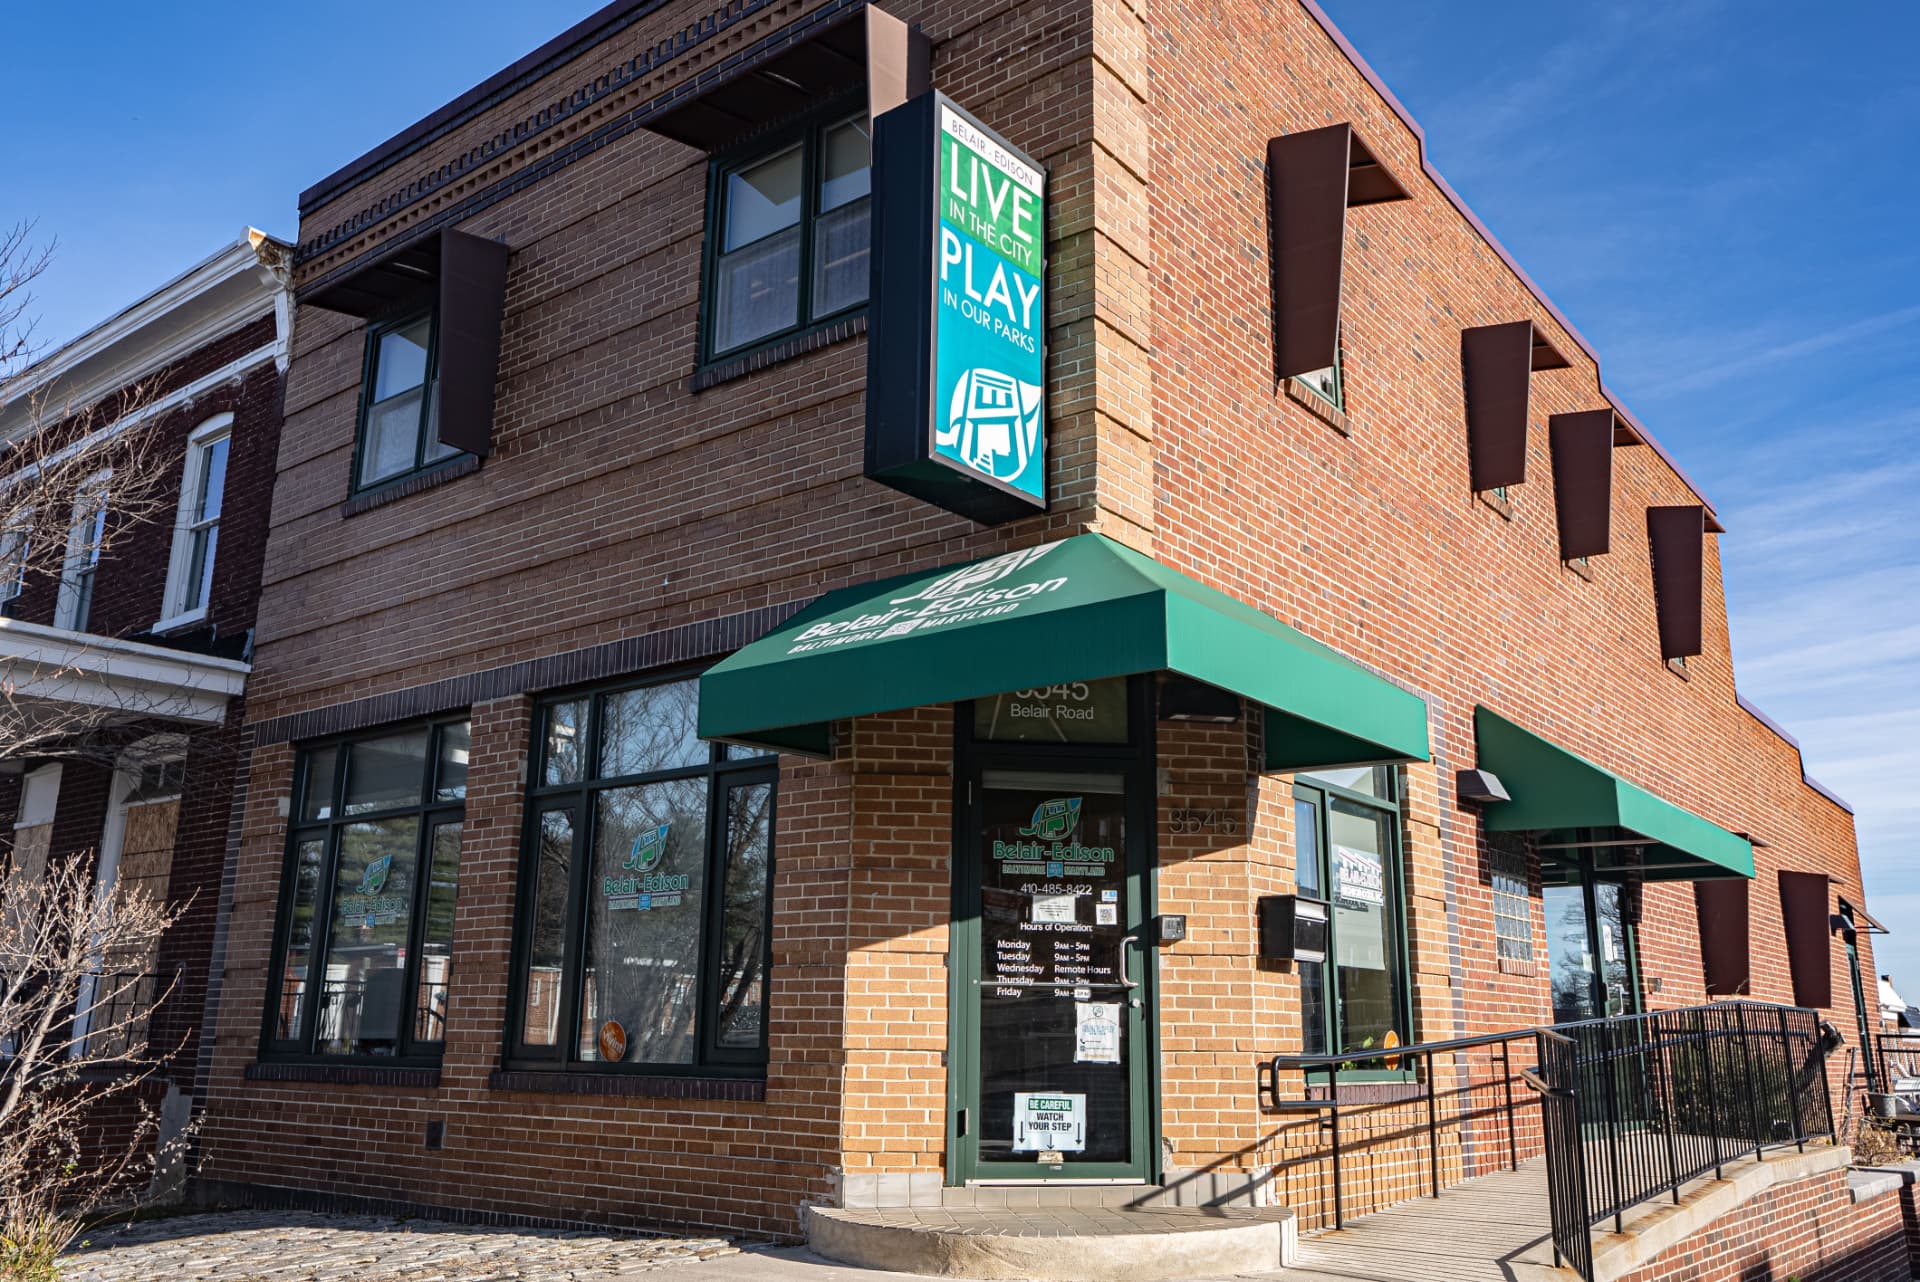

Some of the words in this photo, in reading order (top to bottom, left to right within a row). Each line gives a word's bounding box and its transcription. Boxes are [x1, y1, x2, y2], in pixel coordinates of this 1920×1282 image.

[952, 119, 986, 155] BELAIR
[994, 150, 1033, 186] EDISON
[951, 141, 1033, 244] LIVE
[949, 198, 965, 225] IN
[969, 211, 996, 245] THE
[1000, 233, 1032, 267] CITY
[941, 225, 1040, 330] PLAY
[944, 287, 957, 310] IN
[961, 299, 990, 330] OUR
[994, 318, 1035, 353] PARKS
[793, 577, 1068, 641] Belair-Edison
[918, 603, 1020, 629] MARYLAND
[1010, 703, 1051, 718] Belair
[1056, 704, 1094, 720] Road
[1168, 808, 1238, 835] 3545
[993, 840, 1115, 863] Belair-Edison
[603, 872, 689, 895] Belair-Edison
[1020, 883, 1093, 896] 410-485-8422
[1020, 922, 1042, 932] Hours
[1044, 923, 1053, 931] of
[997, 940, 1031, 951] Monday
[997, 951, 1030, 962] Tuesday
[997, 963, 1045, 974] Wednesday
[1054, 964, 1086, 973] Remote
[1087, 965, 1111, 974] Hours
[997, 975, 1034, 986] Thursday
[997, 987, 1022, 997] Friday
[1030, 1099, 1040, 1109] BE
[1041, 1099, 1072, 1110] CAREFUL
[1036, 1112, 1064, 1121] WATCH
[1028, 1122, 1050, 1131] YOUR
[1052, 1122, 1072, 1132] STEP
